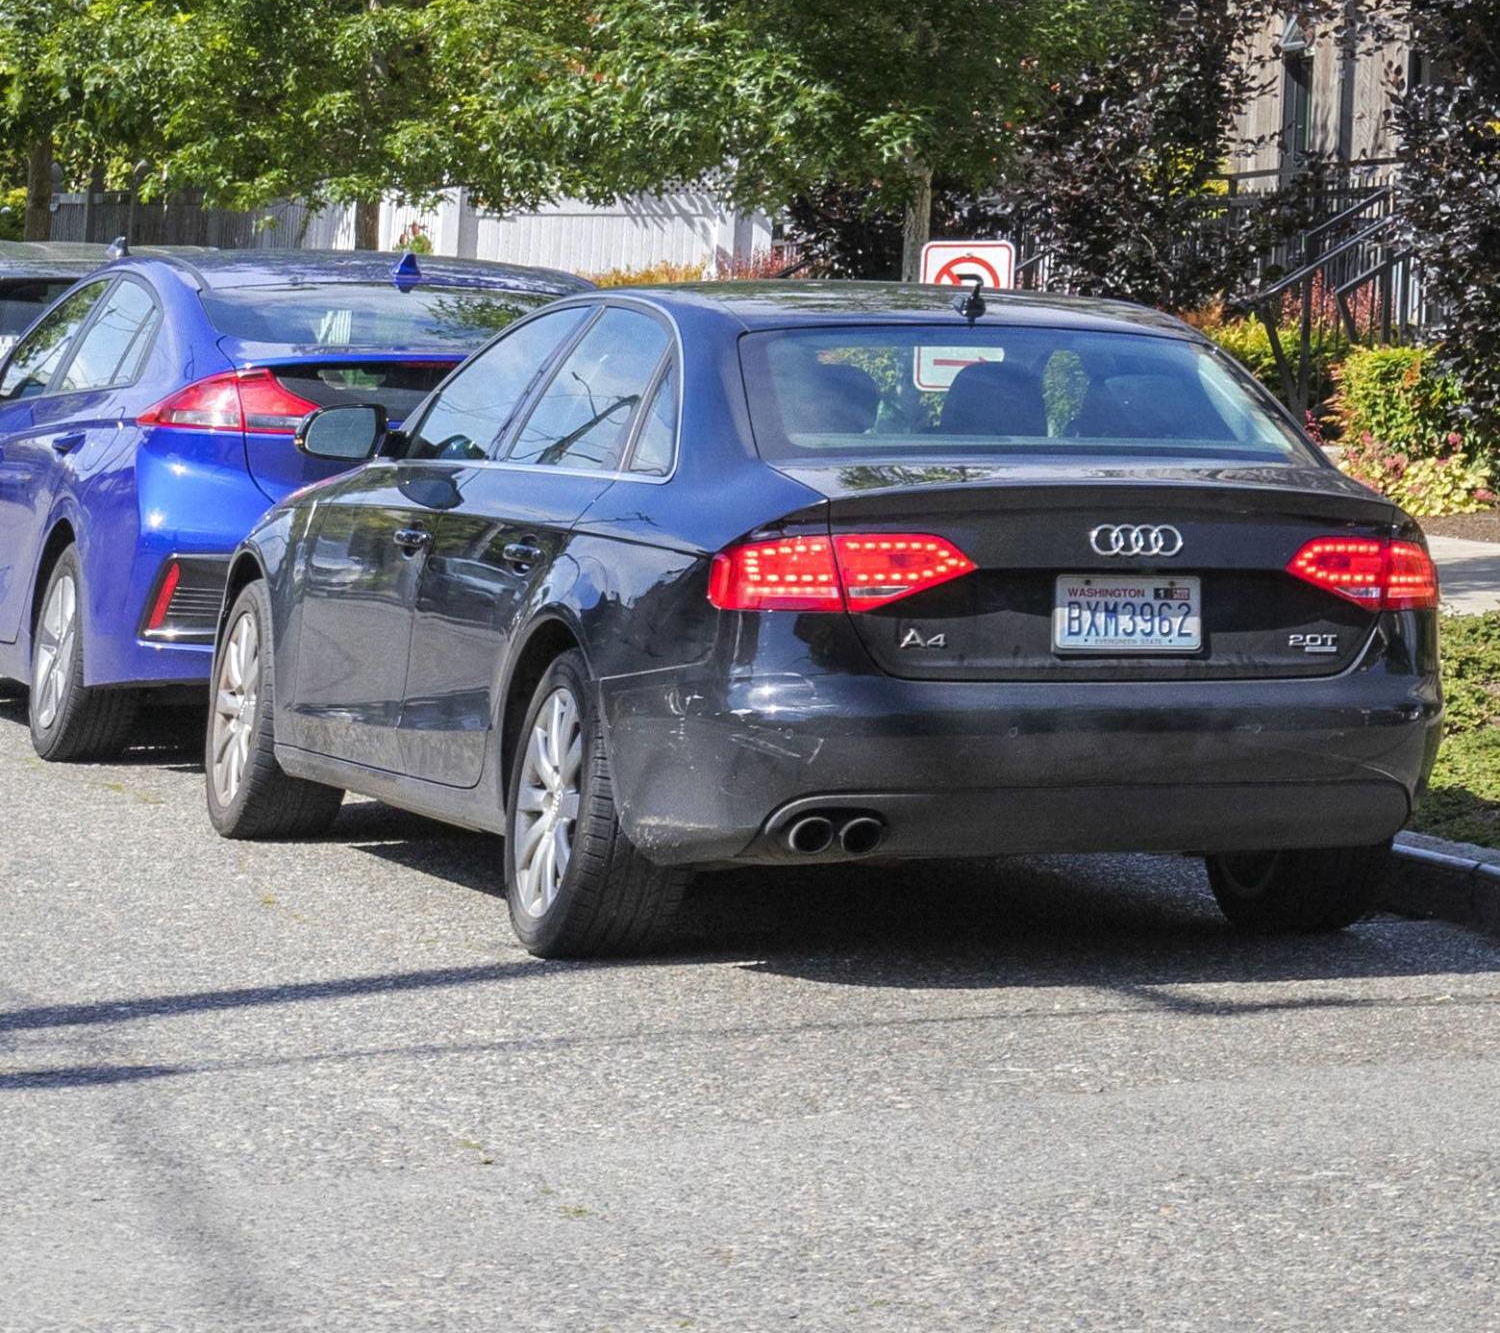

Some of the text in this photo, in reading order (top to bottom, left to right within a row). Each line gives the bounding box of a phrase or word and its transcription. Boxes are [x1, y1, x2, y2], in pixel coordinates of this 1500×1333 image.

[1067, 588, 1145, 598] WASHINGTON
[1067, 600, 1193, 637] BXM3962
[900, 628, 946, 648] A4
[1288, 634, 1337, 646] 2.0T
